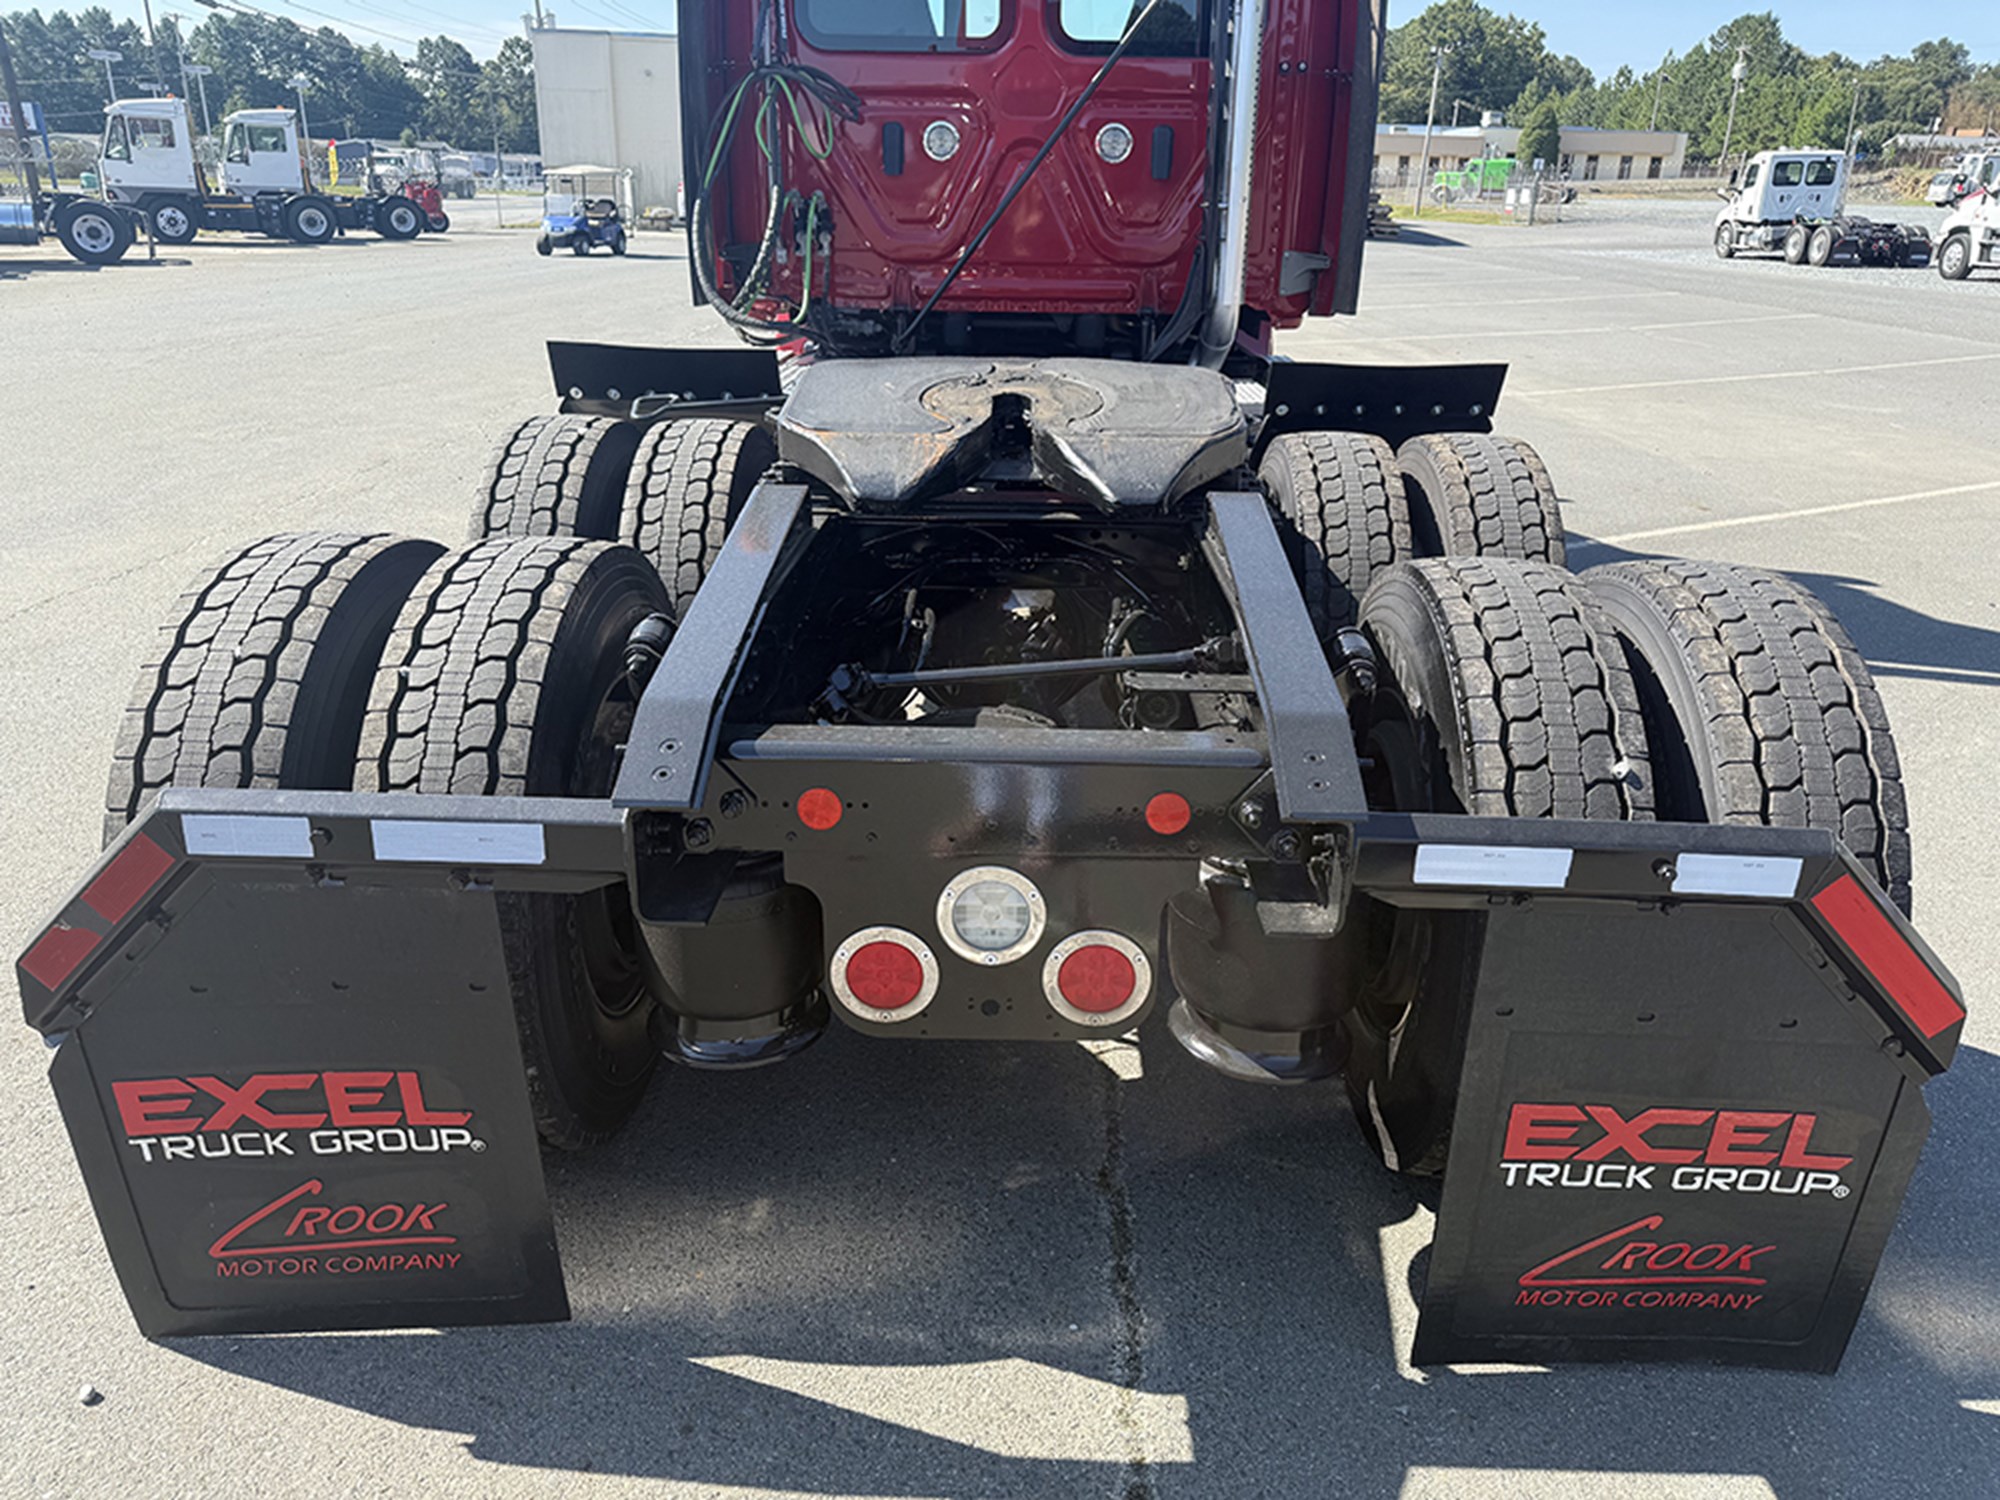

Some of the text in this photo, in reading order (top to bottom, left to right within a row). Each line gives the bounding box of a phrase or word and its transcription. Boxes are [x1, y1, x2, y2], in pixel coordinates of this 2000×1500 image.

[111, 1071, 473, 1137] EXCEL
[128, 1131, 295, 1162] TRUCK
[1502, 1103, 1854, 1171] EXCEL
[1499, 1162, 1656, 1190] TRUCK
[216, 1253, 462, 1277] MOTOR COMPANY
[1515, 1290, 1763, 1310] MOTOR COMPANY
